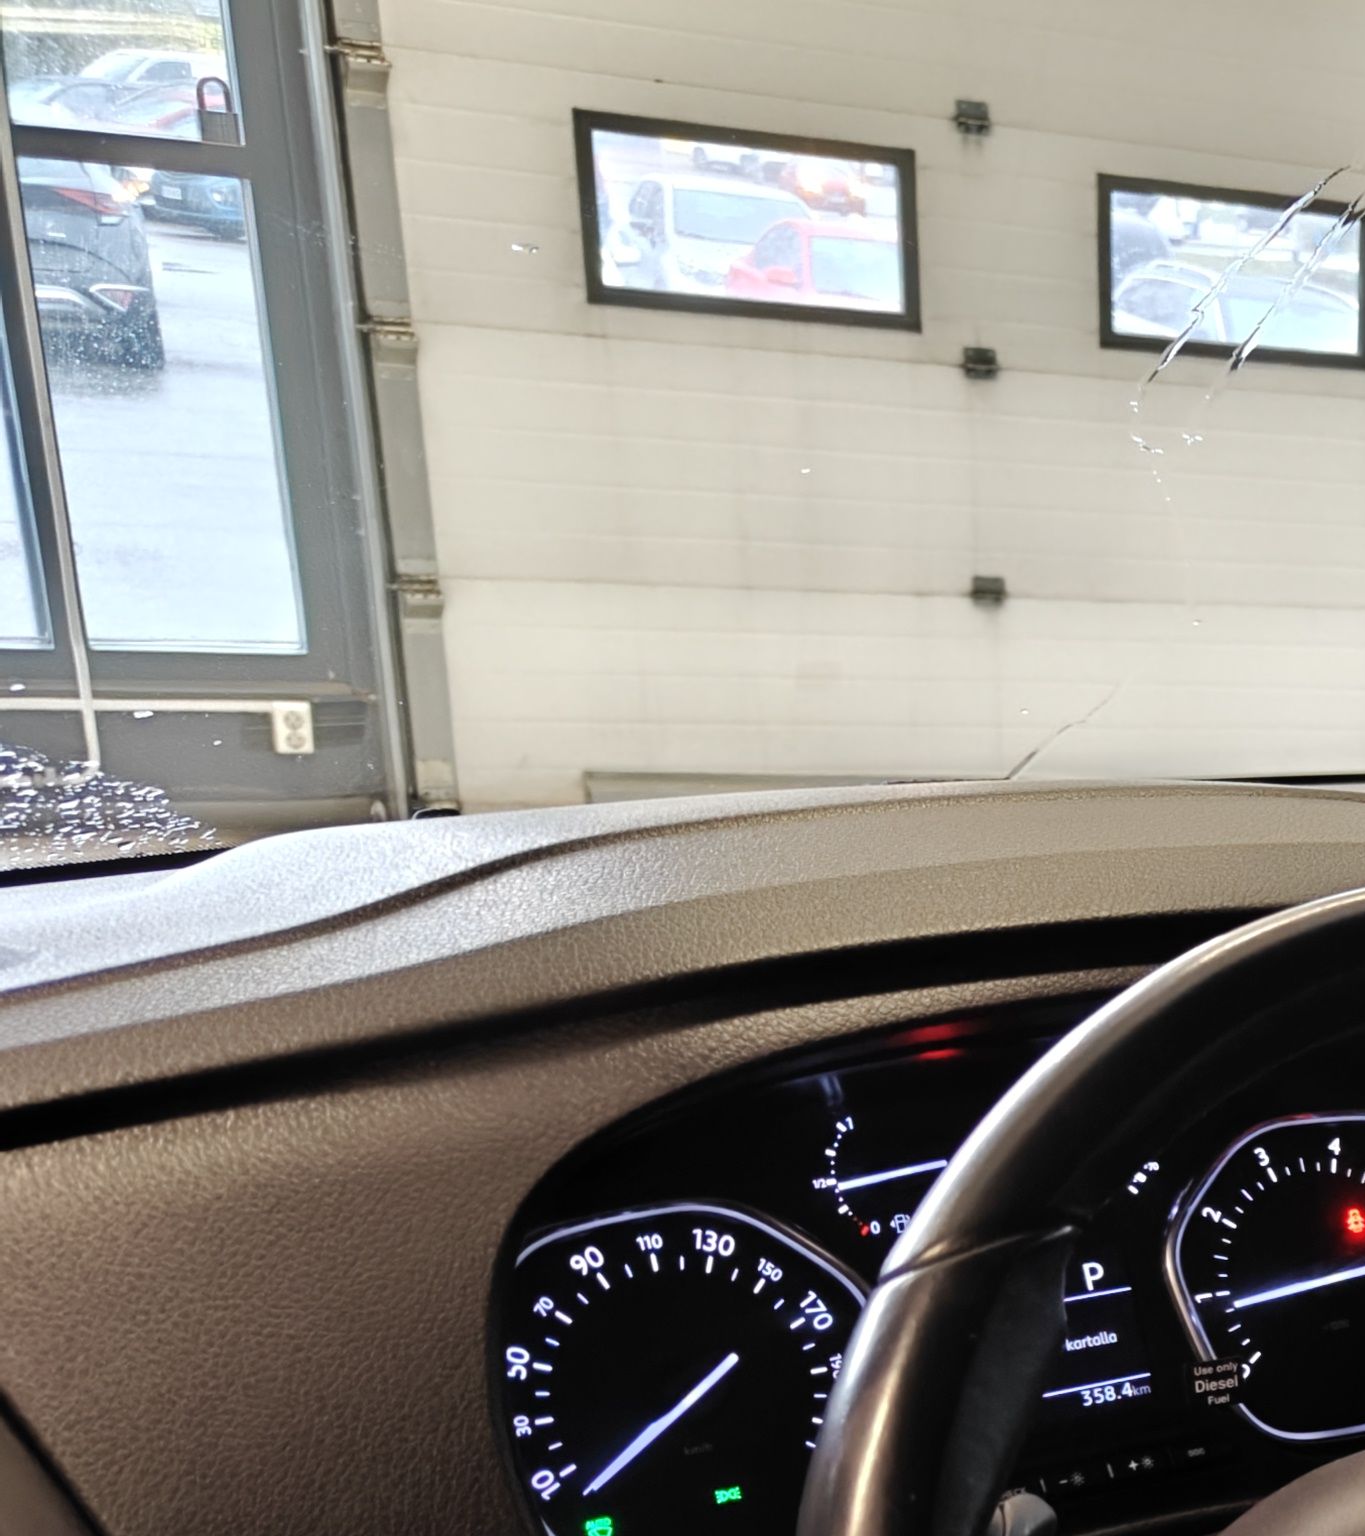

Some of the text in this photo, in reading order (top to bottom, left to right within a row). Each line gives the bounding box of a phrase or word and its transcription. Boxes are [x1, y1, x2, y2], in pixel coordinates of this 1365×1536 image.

[845, 1116, 854, 1130] 1
[1253, 1147, 1270, 1166] 3
[1327, 1137, 1341, 1155] 4
[1202, 1207, 1223, 1223] 2
[870, 1220, 881, 1234] 0
[635, 1233, 664, 1251] 110
[692, 1228, 735, 1257] 130
[569, 1246, 604, 1276] 90
[757, 1257, 783, 1282] 150
[1082, 1261, 1104, 1291] P
[533, 1296, 554, 1317] 70
[800, 1290, 834, 1330] 170
[1065, 1331, 1118, 1352] kartalla
[506, 1346, 530, 1380] 50
[1194, 1362, 1239, 1377] Use only
[1195, 1376, 1239, 1393] Diesel
[1207, 1394, 1230, 1405] Fuel
[513, 1415, 532, 1437] 30
[531, 1469, 561, 1500] 10
